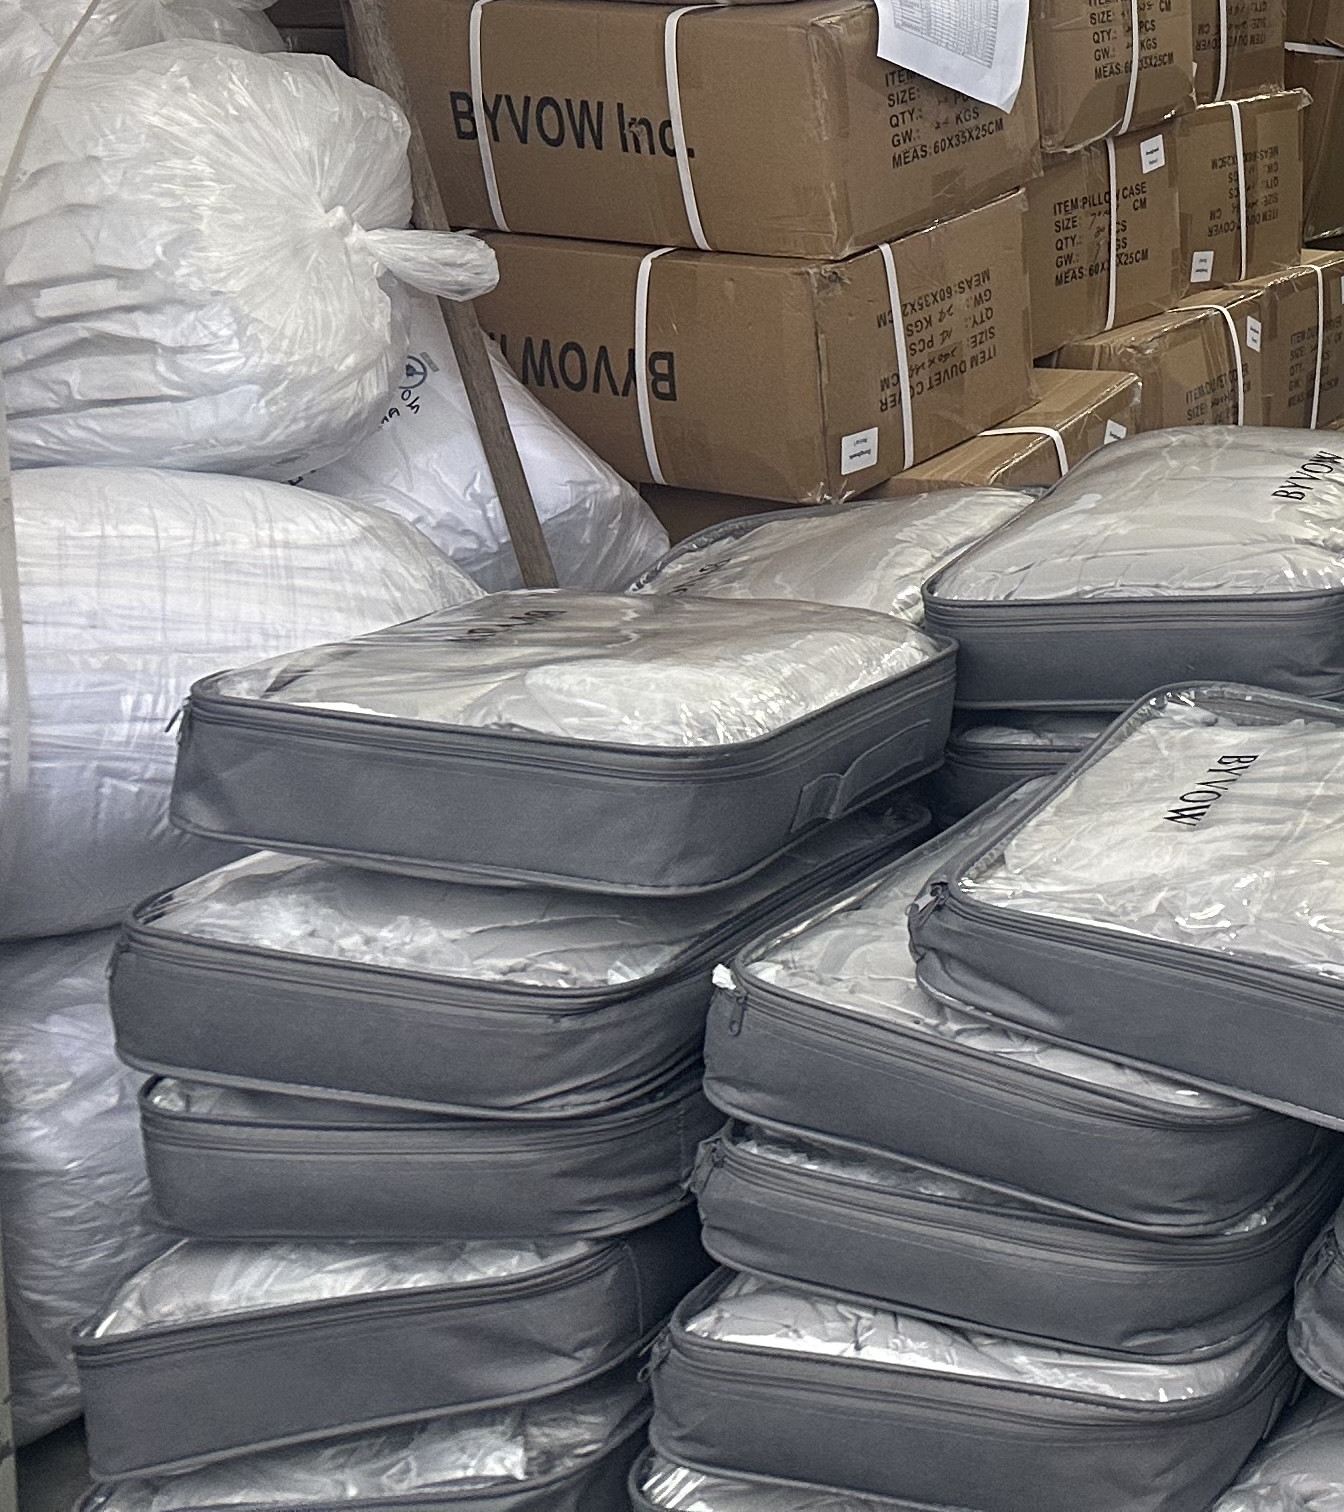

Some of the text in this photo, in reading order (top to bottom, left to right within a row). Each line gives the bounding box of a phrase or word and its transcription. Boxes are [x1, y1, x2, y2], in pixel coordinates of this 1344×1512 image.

[1090, 0, 1172, 26] SIZE: CM
[1139, 19, 1156, 33] PCS
[1140, 38, 1158, 52] KGS
[887, 86, 921, 108] SIZE:
[449, 90, 696, 159] BYVOW Inc.
[955, 106, 980, 126] KGS
[892, 117, 1005, 169] MEAS:60X35X25CM
[1121, 181, 1148, 200] CASE
[1054, 197, 1147, 233] SIZE: CM
[906, 315, 933, 337] KGS
[909, 334, 935, 356] PCS
[970, 344, 997, 370] ITEM
[879, 326, 996, 392] SIZE: CM
[928, 364, 967, 391] DUVET
[1162, 754, 1259, 827] BYVOW
